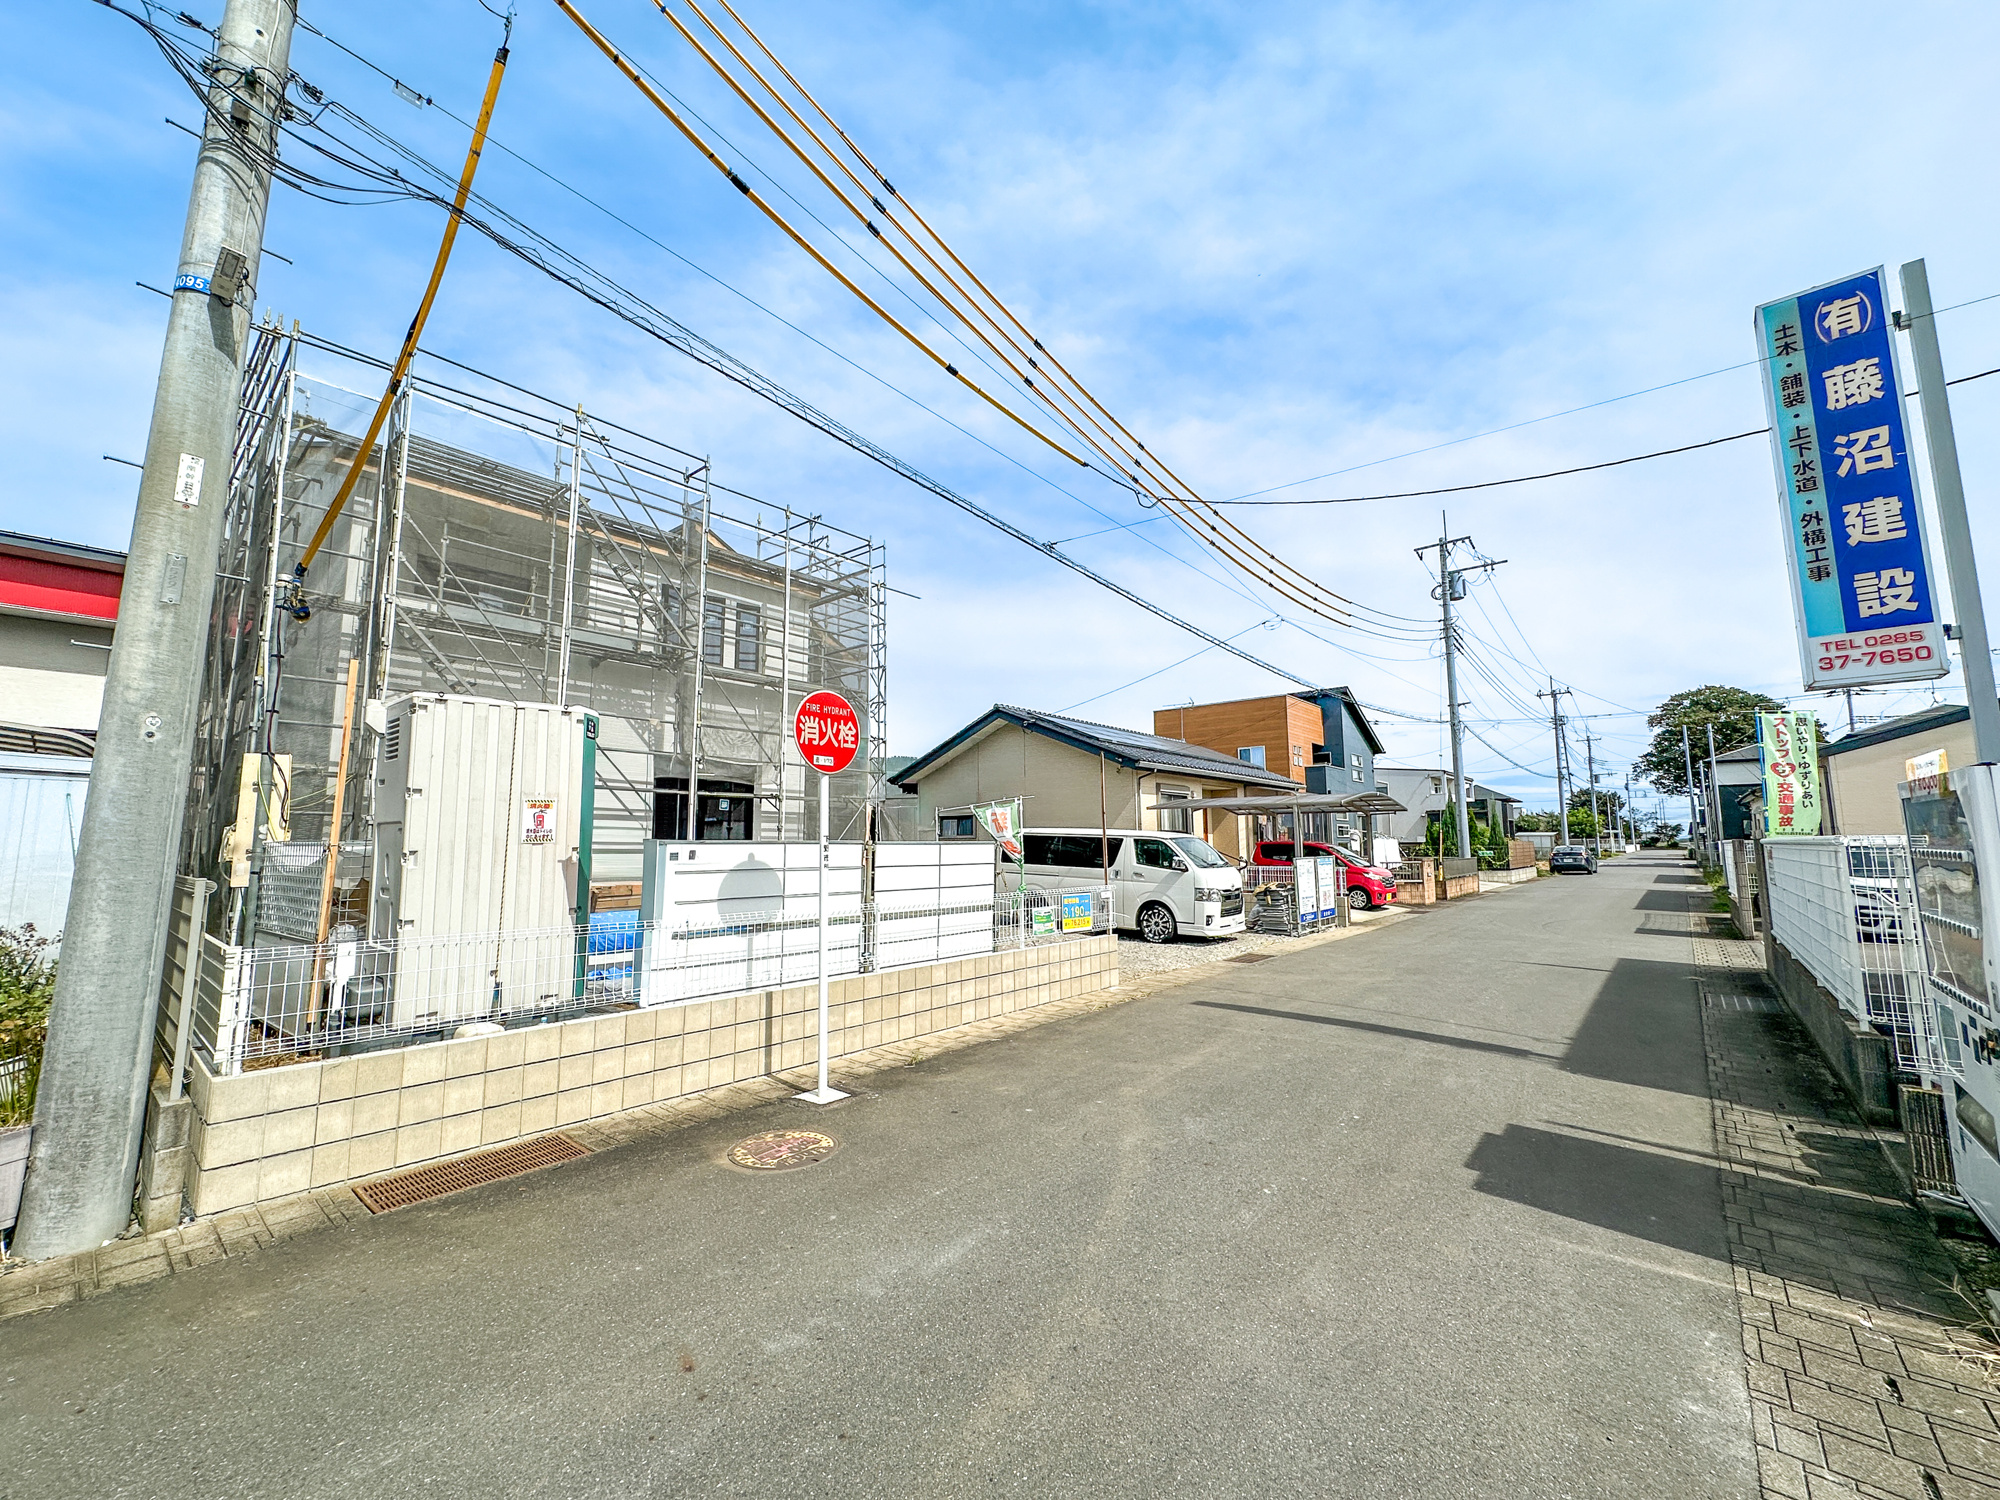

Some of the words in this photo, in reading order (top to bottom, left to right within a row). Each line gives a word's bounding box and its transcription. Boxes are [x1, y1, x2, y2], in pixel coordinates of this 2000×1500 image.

[1818, 645, 1933, 671] 37-7650
[805, 702, 821, 713] FIRE
[823, 705, 851, 717] HYDRANT
[799, 714, 857, 749] 消火栓
[1795, 717, 1814, 809] 思いやり・ゆずりあい
